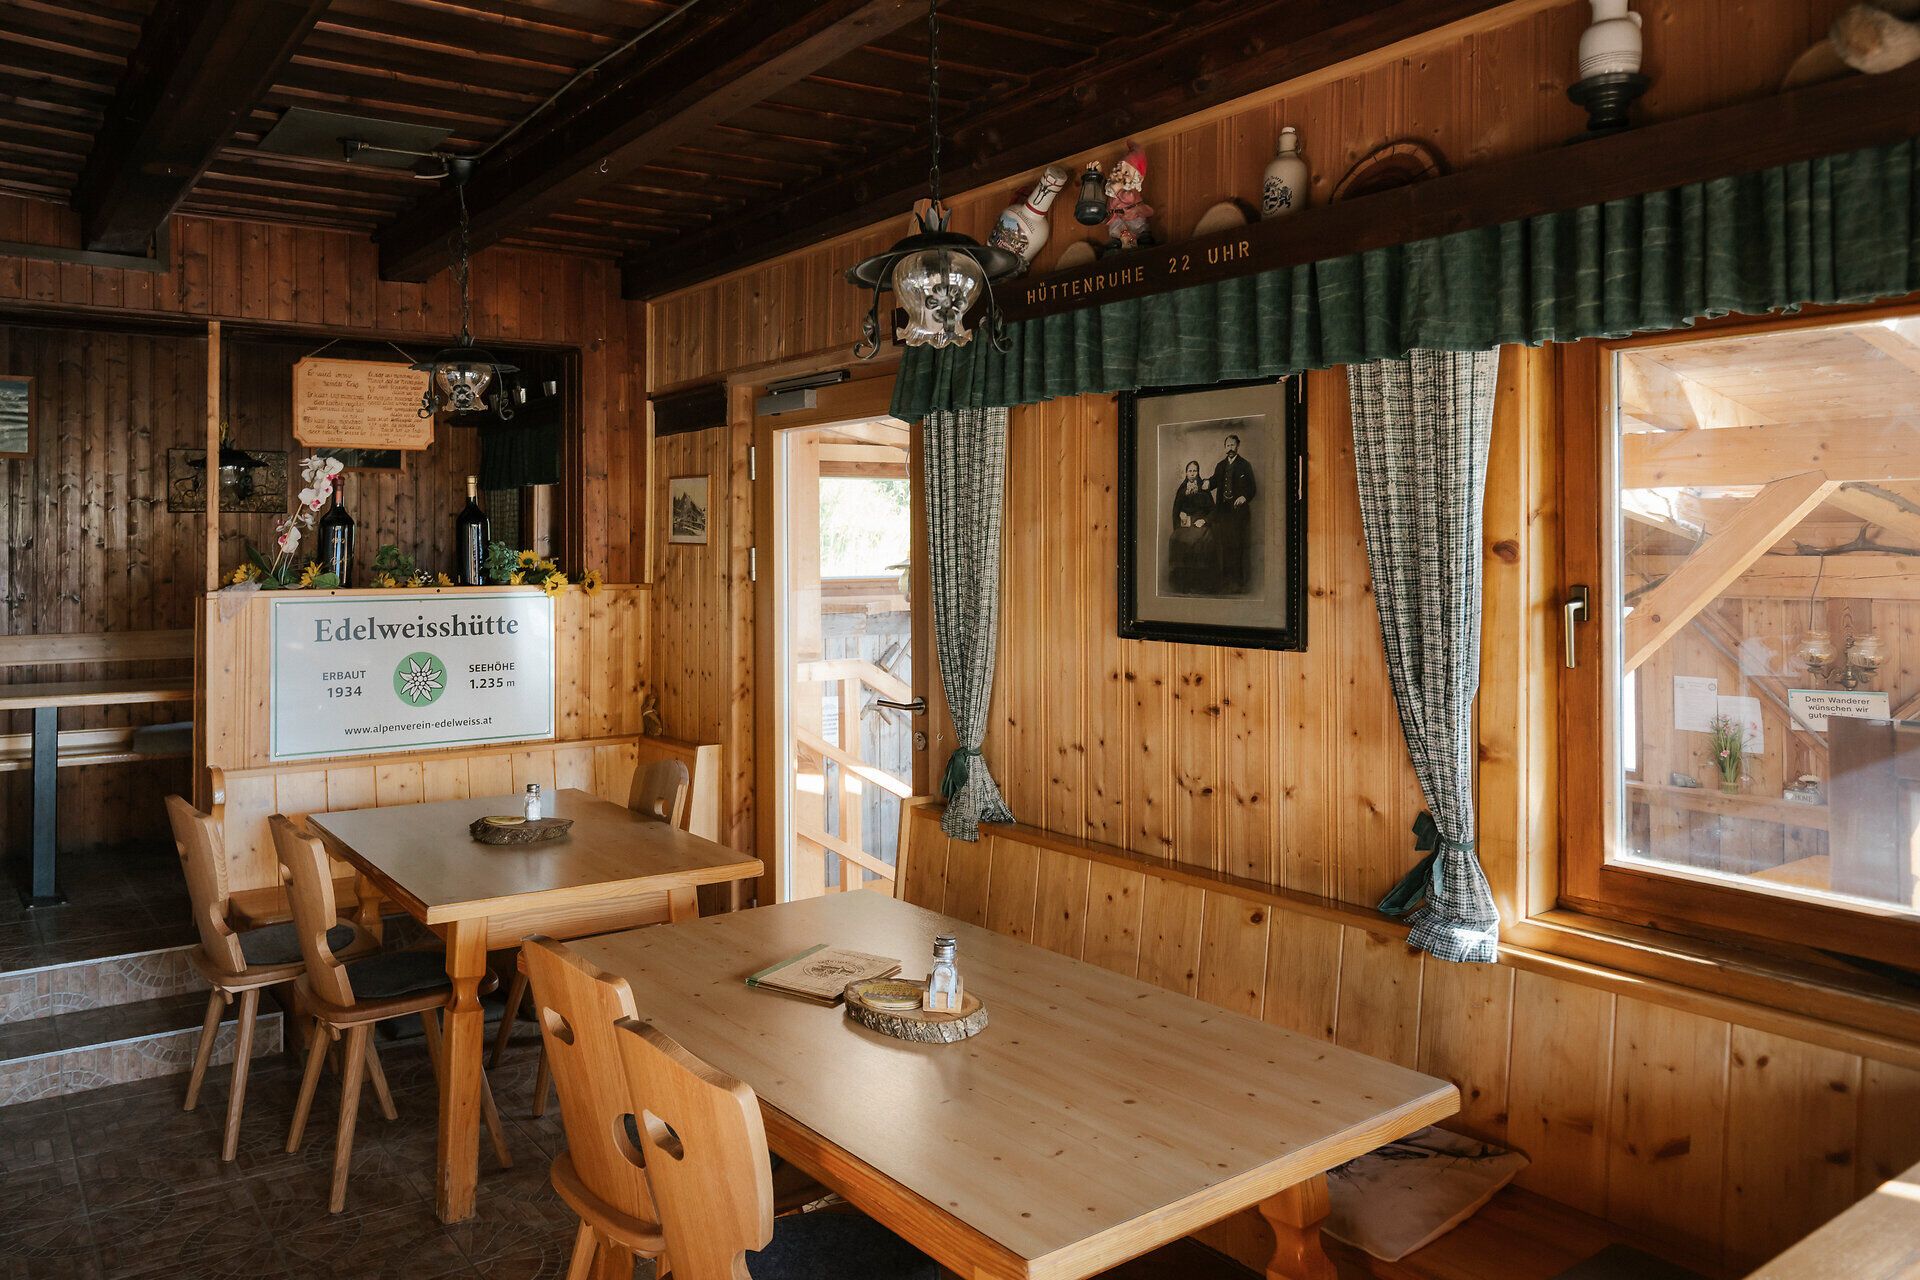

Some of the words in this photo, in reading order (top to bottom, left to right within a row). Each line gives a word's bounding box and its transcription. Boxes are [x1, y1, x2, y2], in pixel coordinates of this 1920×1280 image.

[1026, 265, 1145, 305] HÜTTENRUHE
[1168, 255, 1191, 274] 22
[1207, 240, 1251, 265] UHR
[313, 614, 520, 643] Edelweisshütte
[468, 661, 515, 673] SEEHÖHE
[322, 670, 367, 681] ERBAUT
[469, 677, 504, 690] 1.235
[506, 679, 515, 687] m
[327, 686, 363, 699] 1934
[1808, 704, 1852, 712] wünschen
[344, 716, 493, 736] www.alpenverein-edelweiss.at
